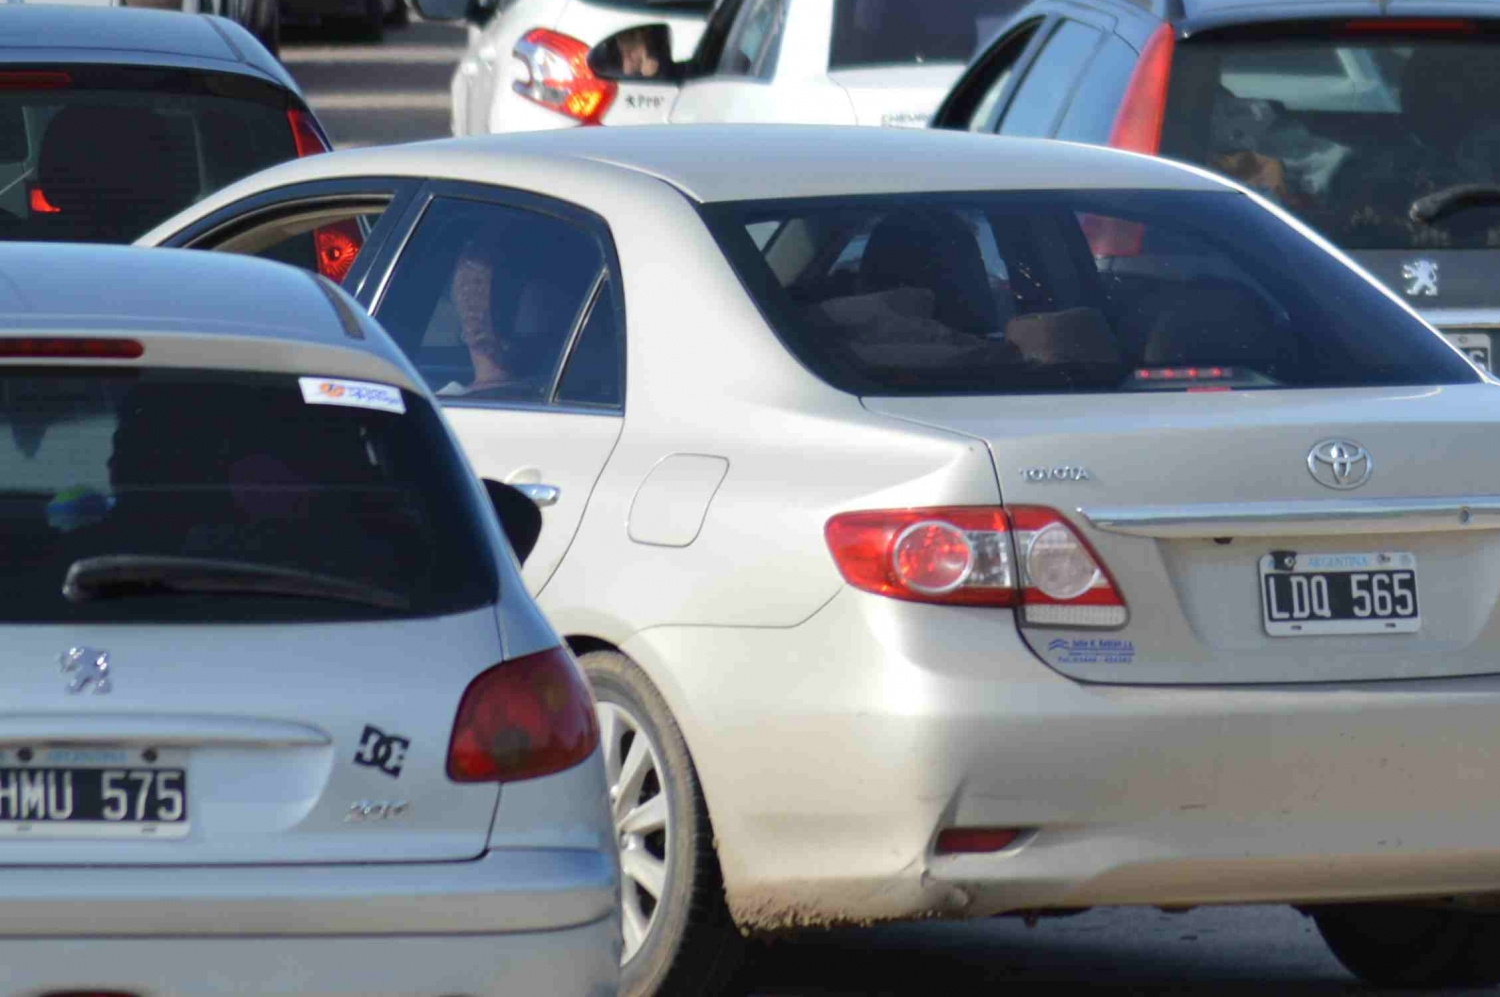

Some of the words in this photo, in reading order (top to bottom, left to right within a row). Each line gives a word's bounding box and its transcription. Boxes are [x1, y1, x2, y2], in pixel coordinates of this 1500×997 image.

[1019, 466, 1091, 482] TOYOTA
[1268, 575, 1332, 619] LDQ
[1350, 573, 1414, 617] 565
[0, 769, 73, 820] HMU
[102, 770, 183, 821] 575
